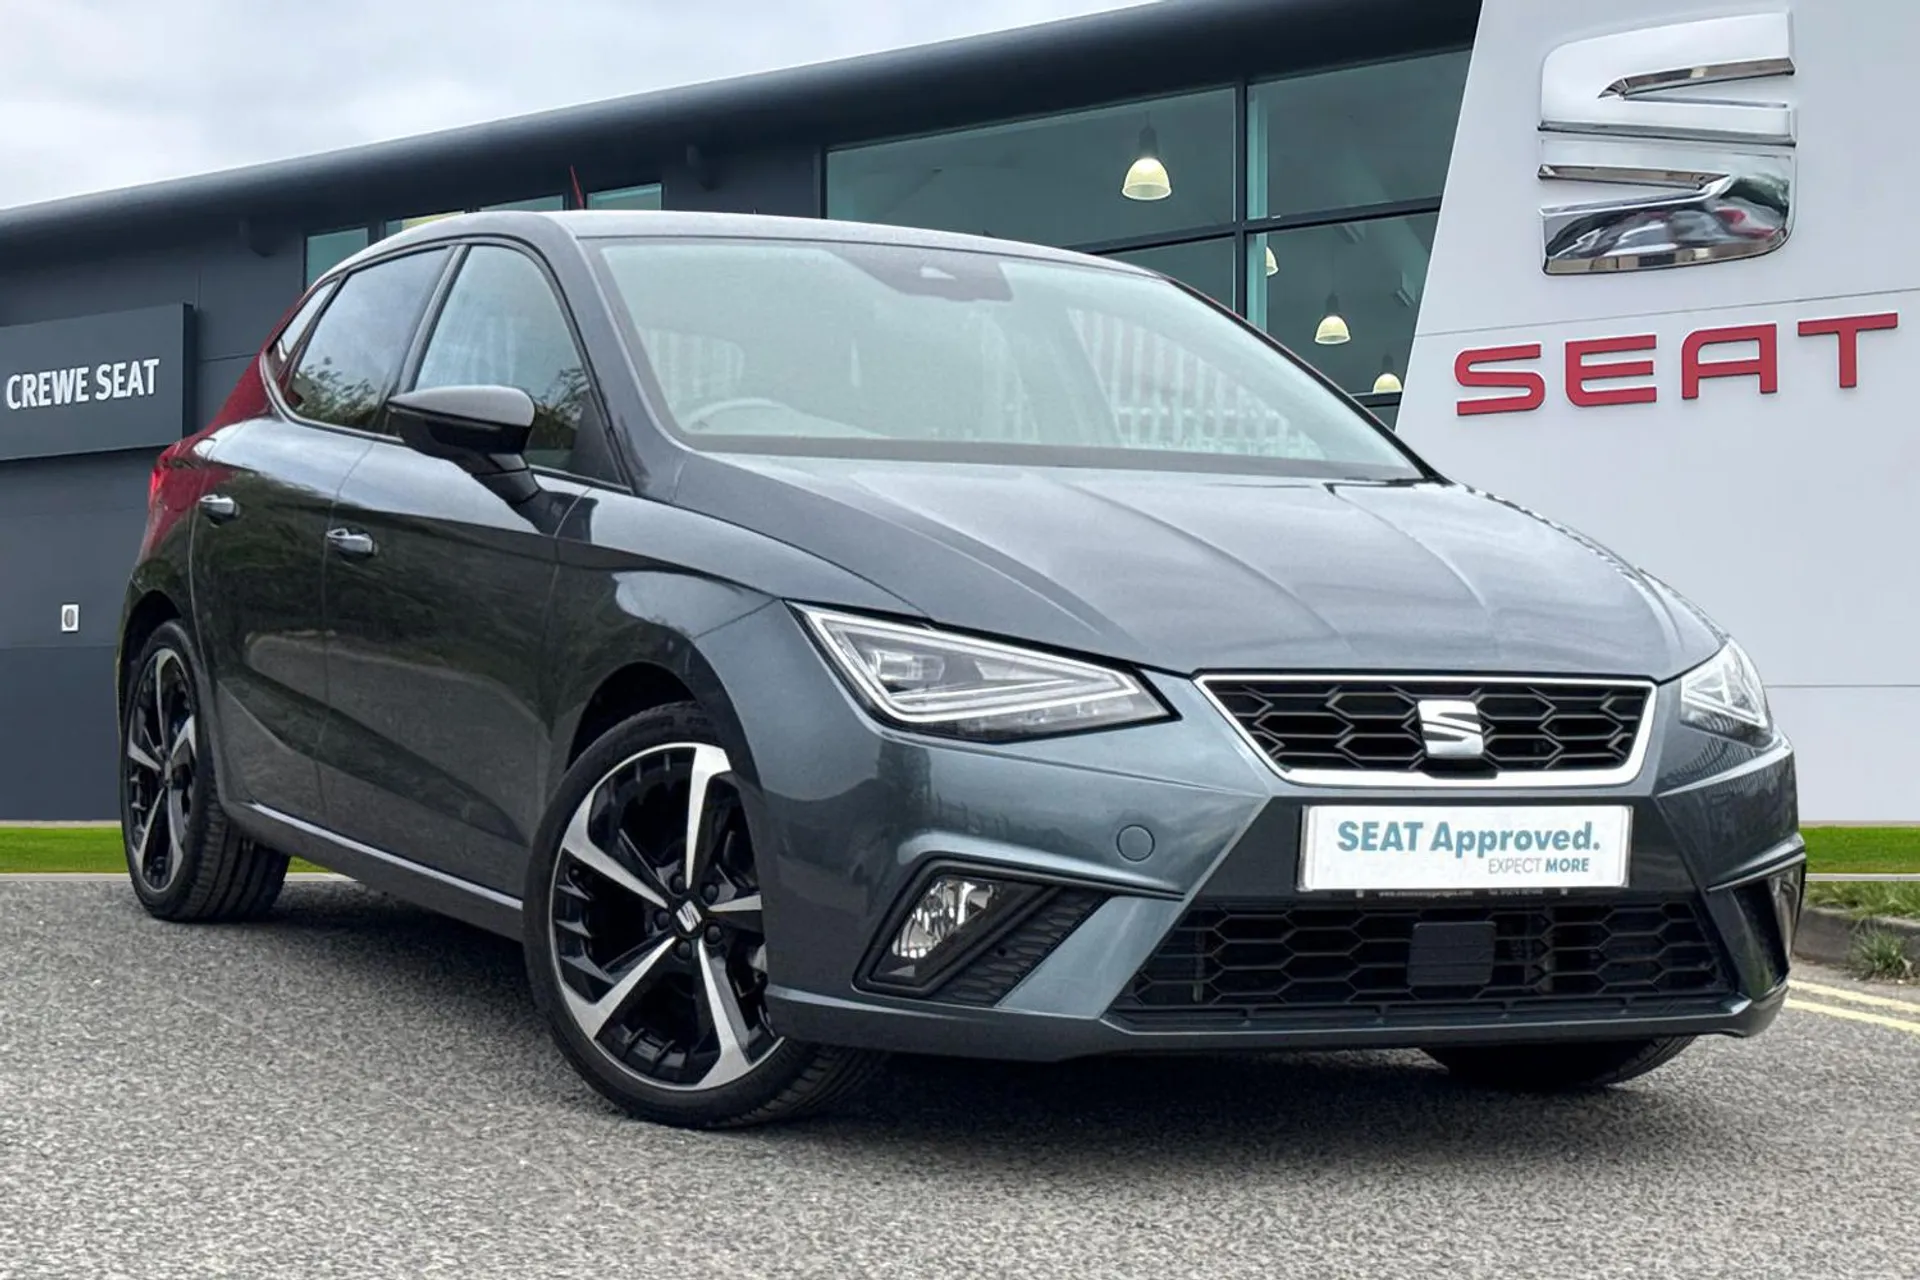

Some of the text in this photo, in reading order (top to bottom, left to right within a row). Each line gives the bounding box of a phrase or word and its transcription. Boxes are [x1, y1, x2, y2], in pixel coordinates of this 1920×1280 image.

[6, 359, 160, 409] CREWE SEAT
[1454, 312, 1898, 416] SEAT
[1337, 821, 1601, 859] SEAT Approved.
[1488, 858, 1590, 874] EXPECT MORE
